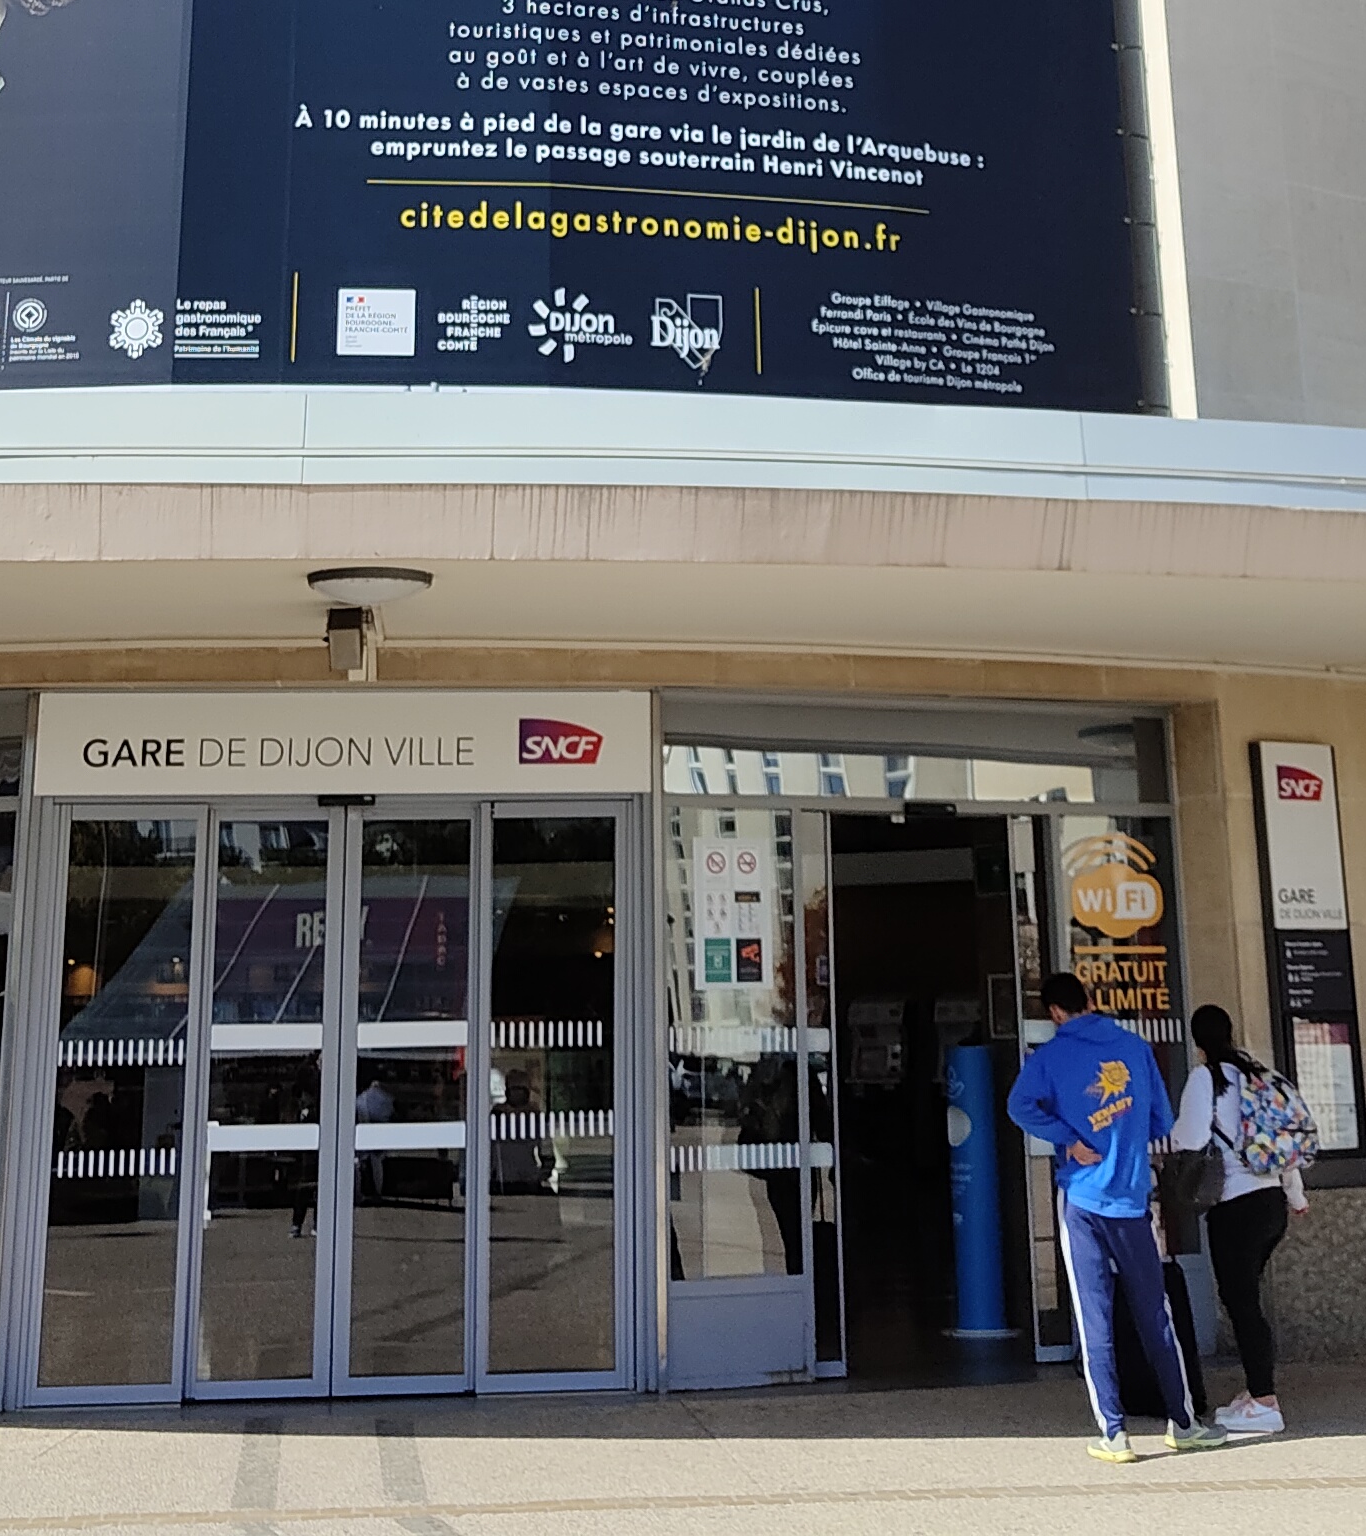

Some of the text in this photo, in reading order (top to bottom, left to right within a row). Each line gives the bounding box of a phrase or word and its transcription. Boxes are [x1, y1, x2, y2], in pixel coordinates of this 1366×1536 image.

[629, 1, 804, 36] d'infrastructures
[449, 21, 861, 65] touristiques et patrimoniales dédiées
[448, 48, 854, 89] au goût et à l'art de vivre, couplées
[456, 69, 847, 113] à de vastes espaces d'expositions.
[294, 103, 313, 129] À
[323, 108, 351, 129] 10
[358, 109, 452, 131] minutes
[459, 111, 474, 131] à
[482, 111, 536, 137] pied
[543, 112, 572, 134] de
[580, 114, 602, 136] la
[609, 123, 662, 143] gare
[669, 122, 704, 143] via
[711, 124, 733, 145] le
[739, 127, 806, 151] jardin
[812, 131, 841, 153] de
[846, 134, 972, 167] l'Arquebuse
[370, 136, 924, 186] empruntez le passage souterrain Henri Vincenot
[400, 200, 901, 254] citedelagastronomie-dijon.fr
[176, 298, 227, 312] Le repas
[461, 296, 507, 311] RÉGION
[831, 292, 871, 307] Groupe
[874, 294, 909, 311] Eiffage
[926, 300, 960, 316] Village
[175, 312, 262, 325] gastronomique
[367, 311, 397, 320] RÉGION
[437, 312, 511, 324] BOURGOGNE
[820, 306, 1045, 338] Ferrandi Paris École des Vins de Bourgogne
[174, 325, 197, 337] des
[344, 326, 409, 334] FRANCHE-COMTÉ
[446, 325, 501, 338] FRANCHE
[563, 331, 633, 346] métropole
[650, 315, 720, 358] Dijon
[811, 318, 851, 334] Épicure
[853, 326, 879, 336] cave
[881, 327, 891, 336] et
[894, 329, 946, 342] restaurants
[1029, 339, 1055, 353] Dijon
[437, 337, 478, 351] COMTÉ
[833, 337, 862, 349] Hôtel
[864, 338, 926, 354] Sainte-Anne
[943, 346, 980, 360] Groupe
[875, 354, 1000, 375] Village by CA Le 1204
[852, 368, 885, 381] Office
[887, 370, 901, 382] de
[903, 373, 944, 385] tourisme
[946, 375, 972, 389] Dijon
[82, 736, 475, 768] GARE DE DIJON VILLE
[521, 735, 599, 761] SNCF
[1280, 777, 1321, 798] SNCF
[1277, 887, 1316, 904] GARE
[1294, 907, 1322, 920] DIJON
[1075, 960, 1168, 983] GRATUIT
[1094, 981, 1171, 1011] LIMITÉ
